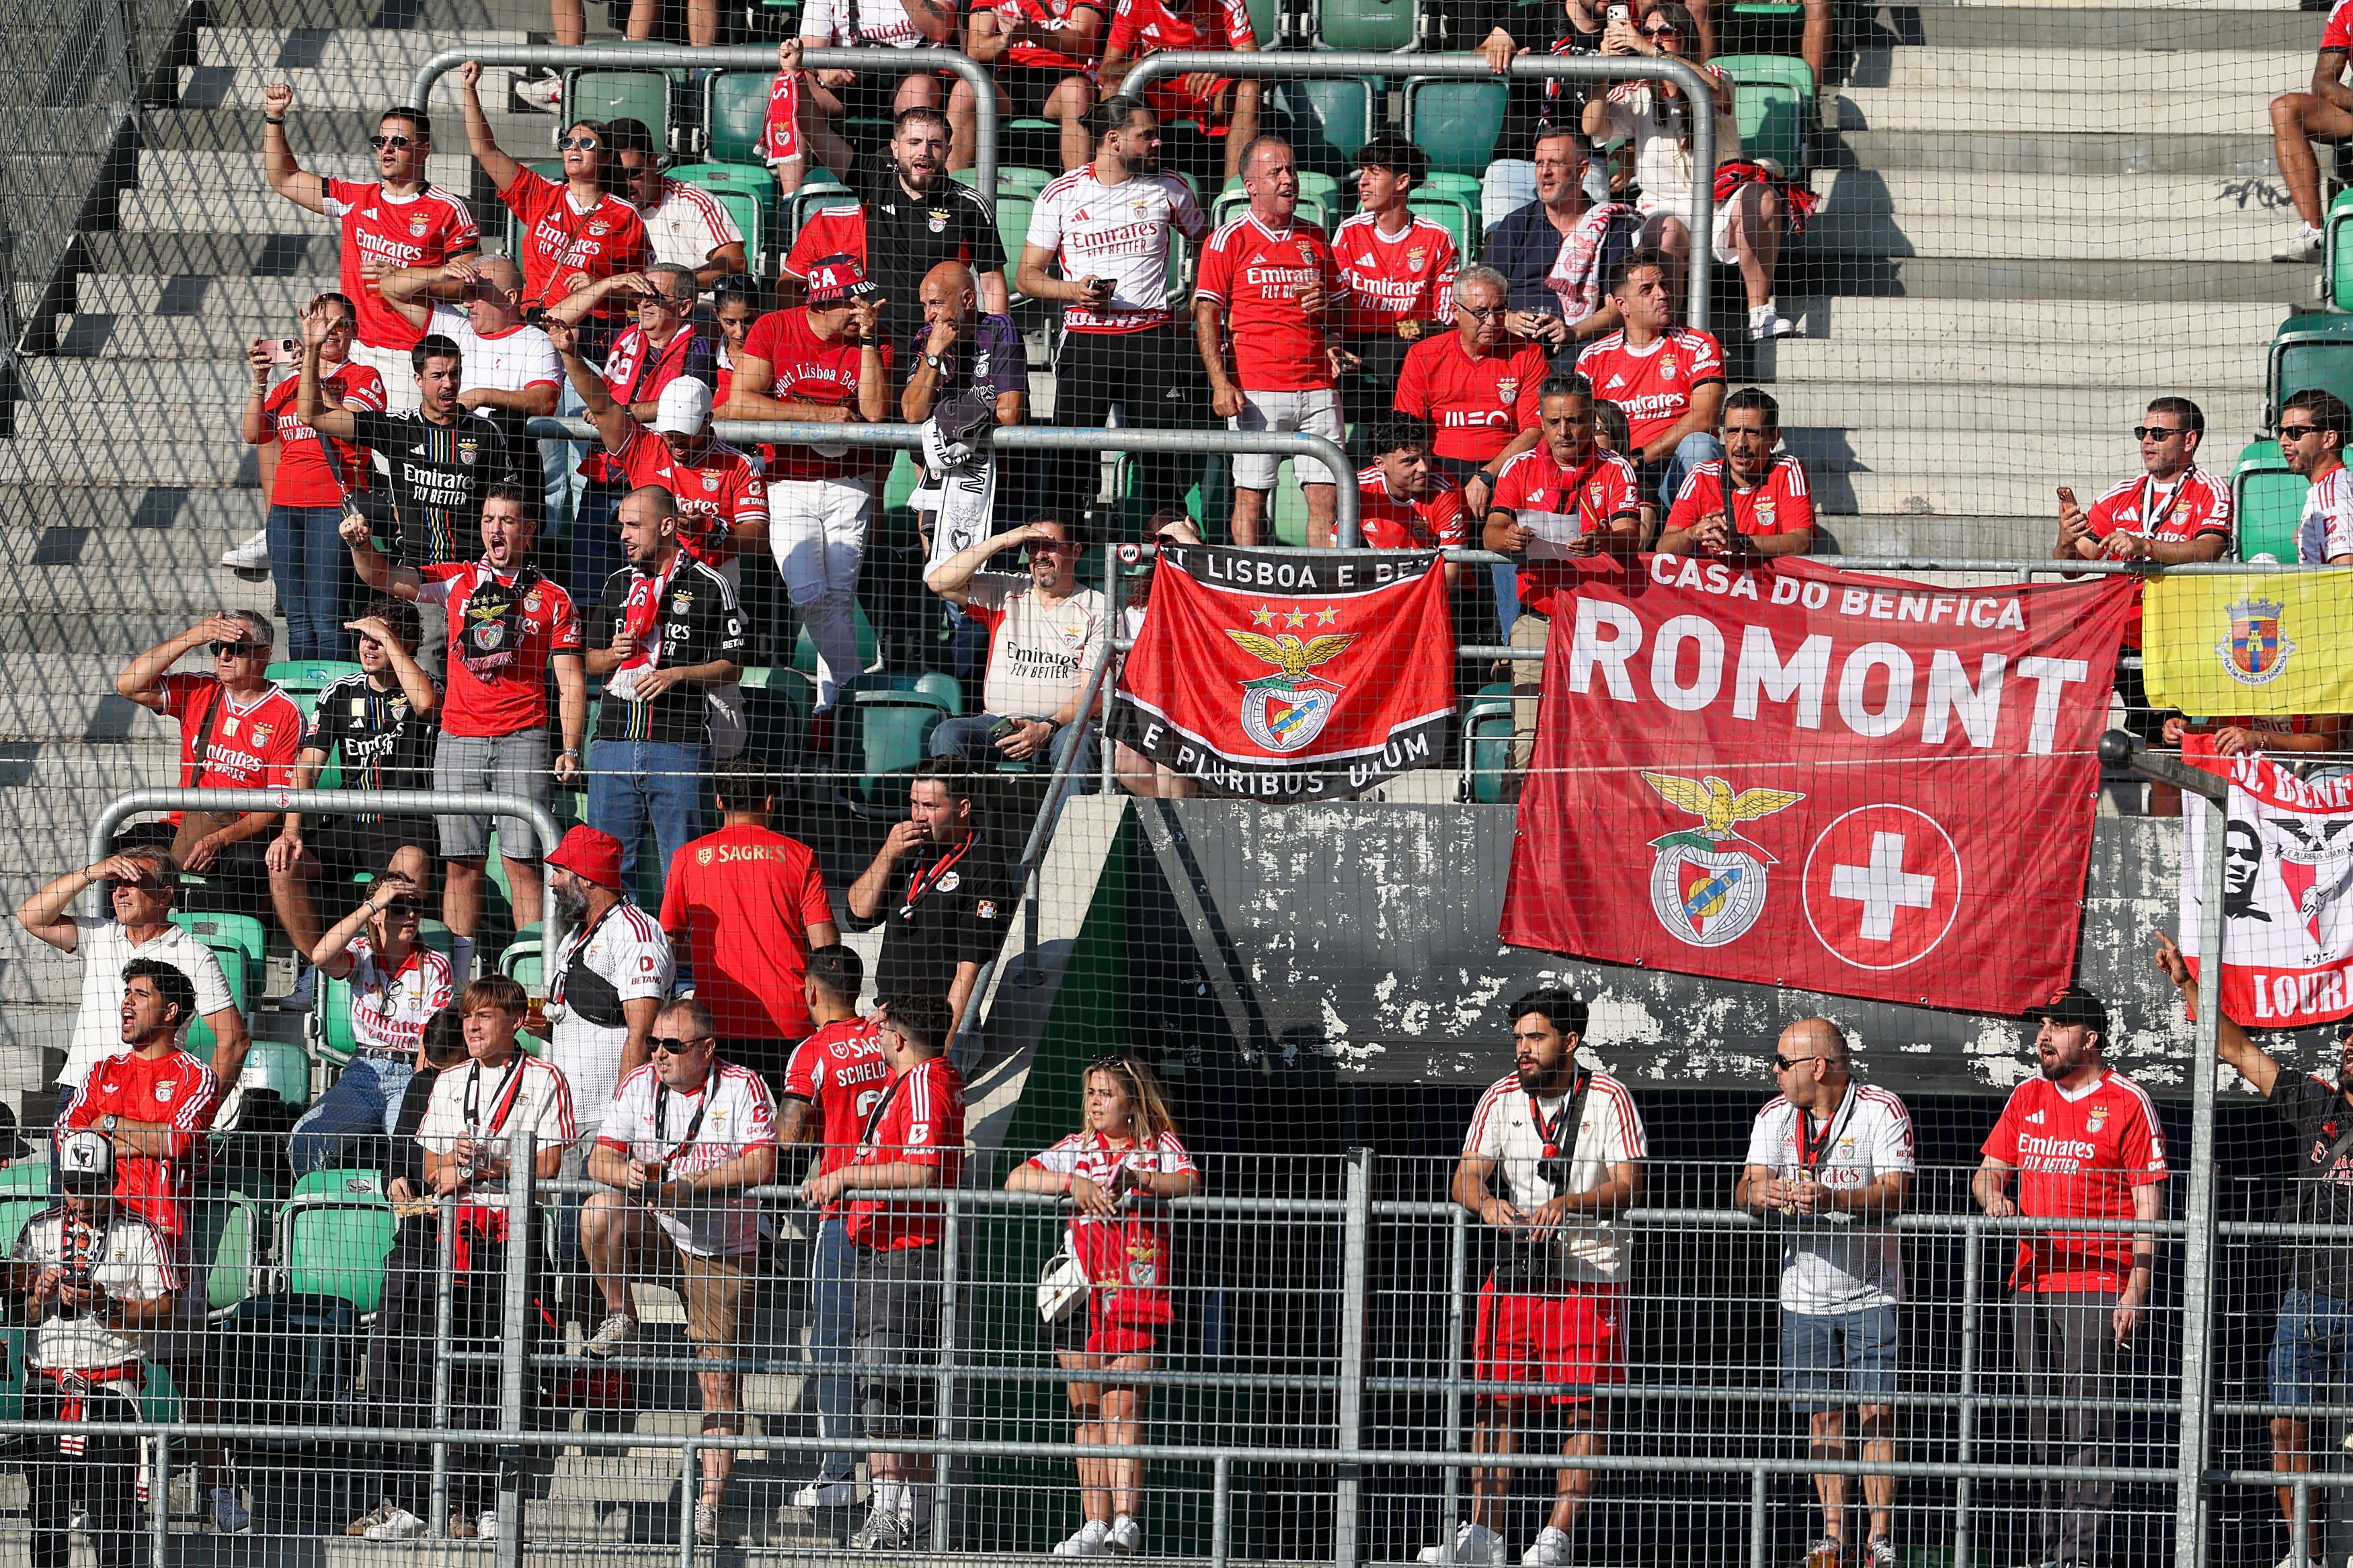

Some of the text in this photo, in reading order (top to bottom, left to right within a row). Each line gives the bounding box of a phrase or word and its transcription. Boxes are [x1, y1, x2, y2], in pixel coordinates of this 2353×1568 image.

[356, 227, 423, 261] Emirates
[1074, 221, 1158, 249] Emirates
[850, 280, 878, 295] 190
[1261, 284, 1279, 299] FLY
[1361, 294, 1380, 309] FLY
[796, 362, 836, 382] Lisboa
[358, 387, 383, 409] BETANO
[1613, 393, 1685, 413] mirates
[403, 462, 477, 491] Emirates
[413, 485, 467, 505] FLY BETTER
[1208, 554, 1318, 589] LISBOA
[1339, 565, 1355, 587] E
[1650, 552, 2026, 632] CASA DO BENFICA
[1007, 641, 1079, 670] Emirates
[1010, 662, 1069, 679] FLY BETTER
[1568, 597, 2089, 755] ROMONT
[1143, 724, 1165, 751] E
[1176, 747, 1324, 796] PLURIBUS
[719, 844, 786, 863] SAGRES
[2293, 851, 2323, 860] PLURIBUS
[2324, 848, 2346, 860] UNUM
[631, 976, 662, 985] BETANO
[354, 996, 420, 1034] Emirate
[2018, 1132, 2096, 1159] Emirates
